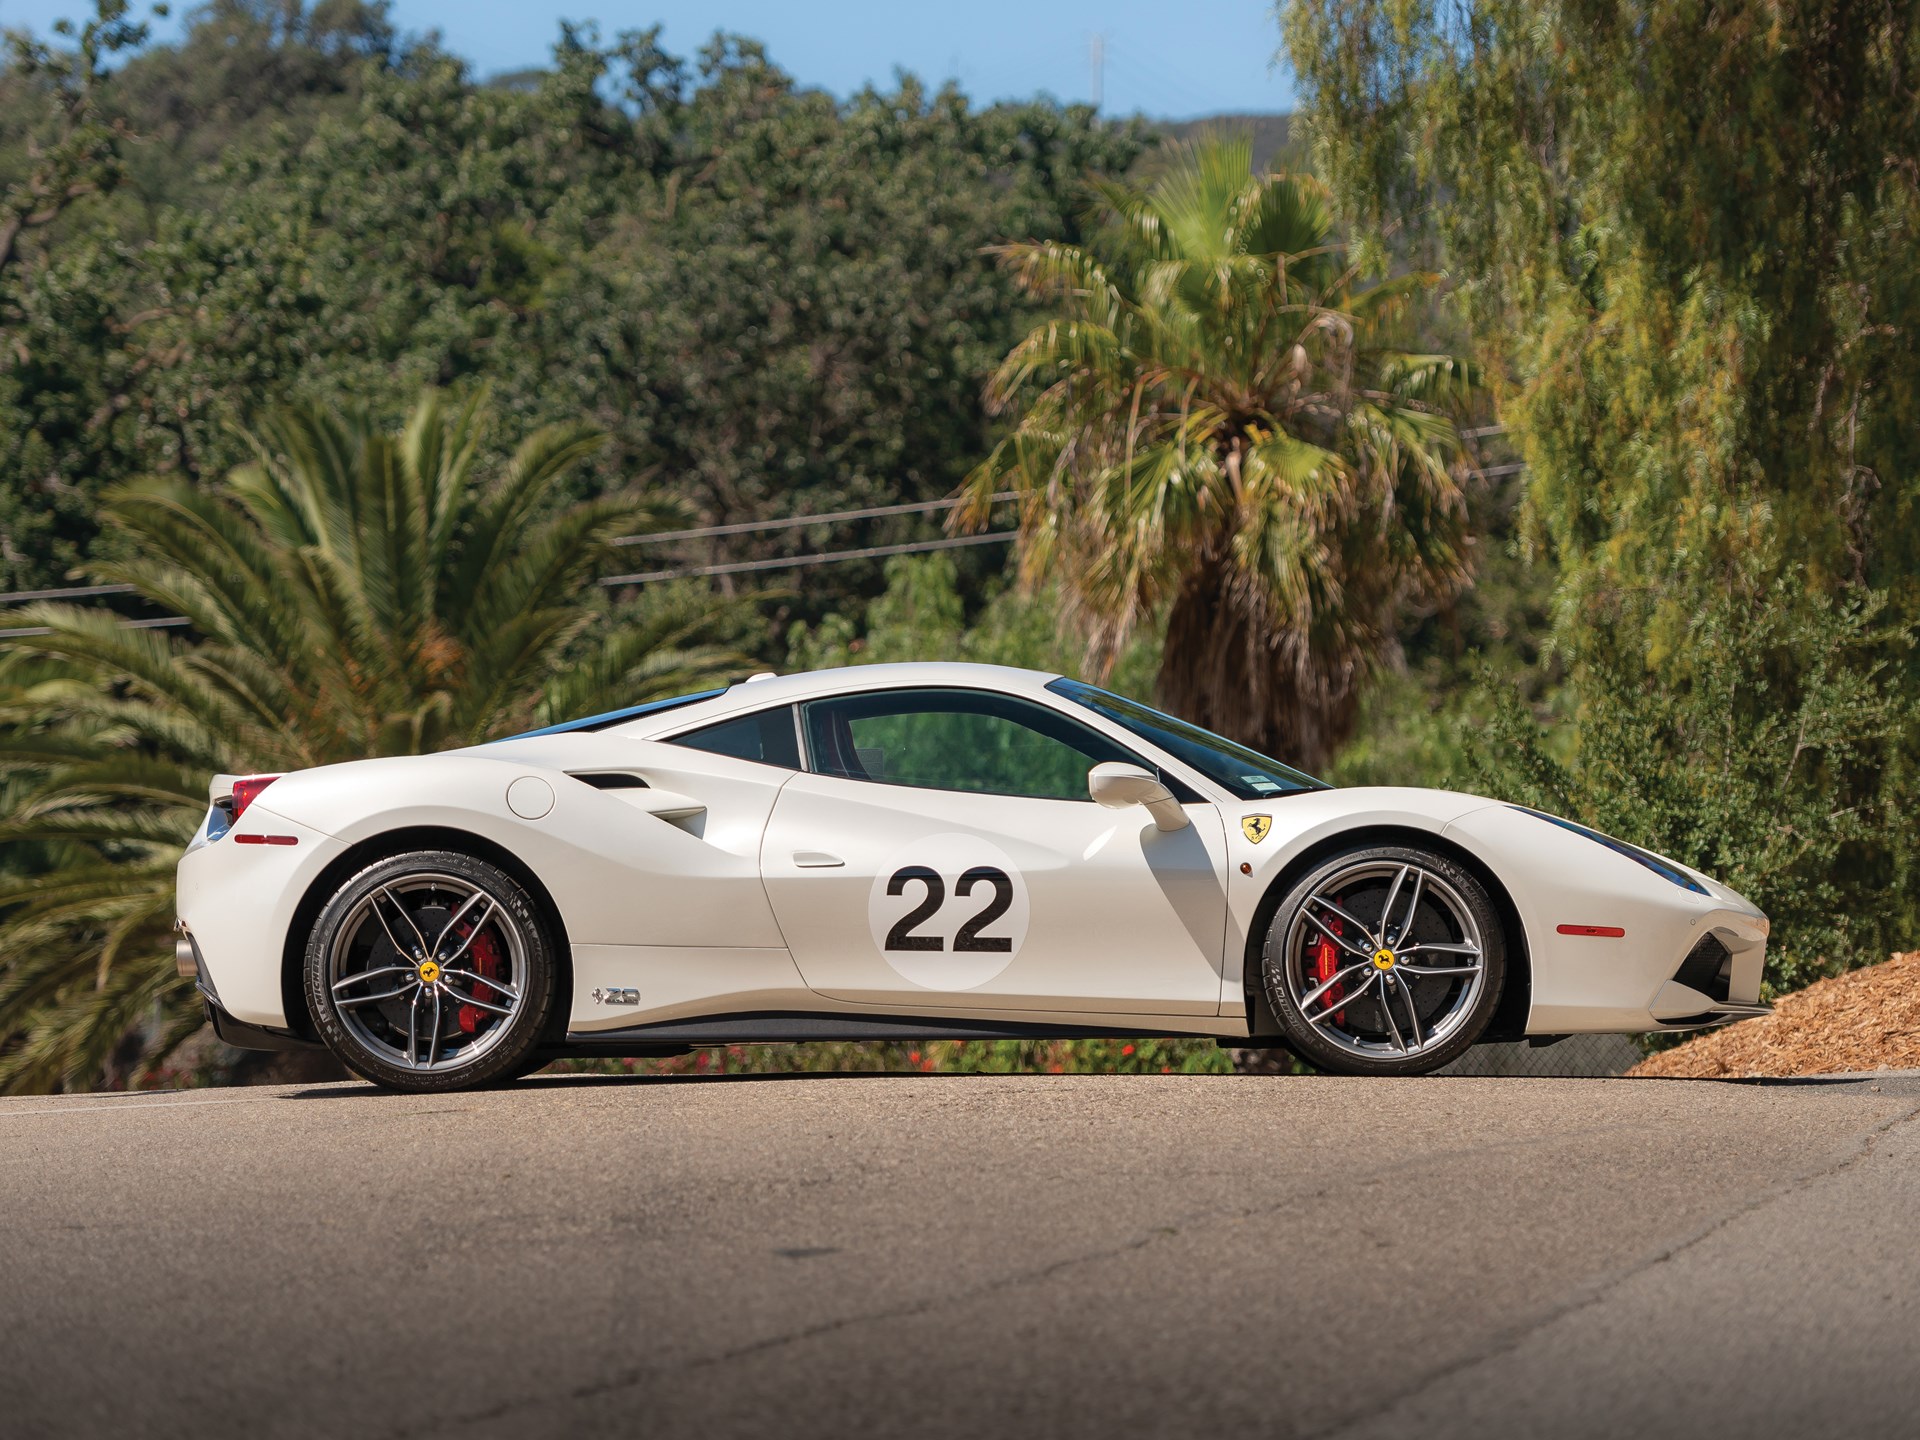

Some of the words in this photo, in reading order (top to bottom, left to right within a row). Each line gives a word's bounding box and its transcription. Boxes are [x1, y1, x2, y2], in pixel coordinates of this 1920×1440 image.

[884, 865, 1013, 952] 22
[312, 943, 324, 1006] MICHELIN
[1275, 987, 1306, 1034] MICHELIN
